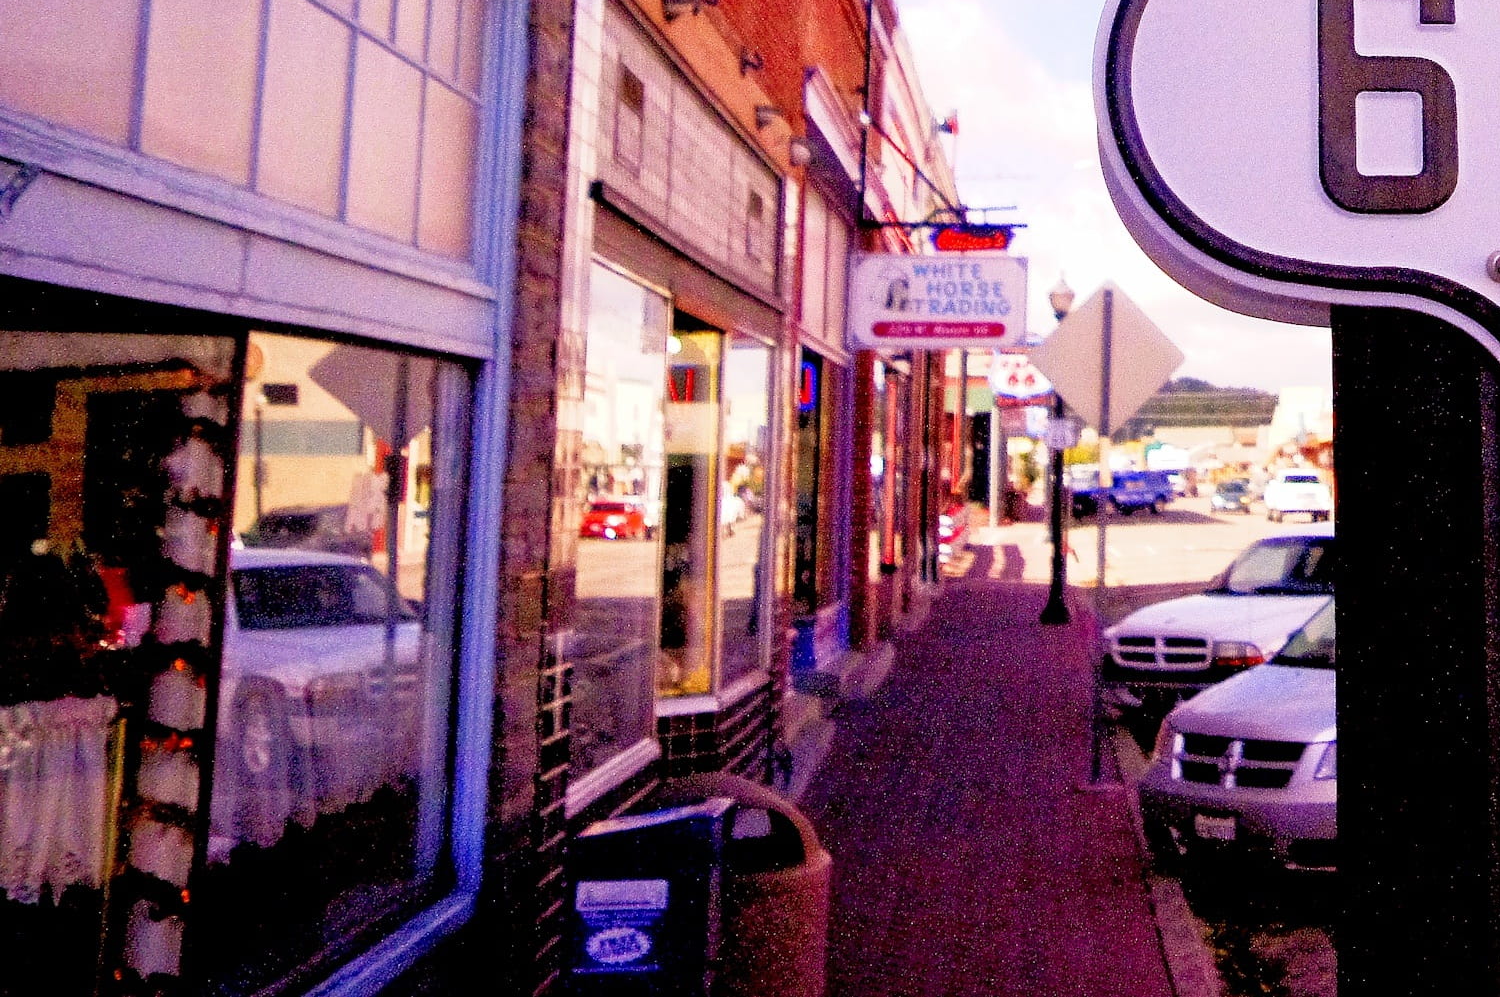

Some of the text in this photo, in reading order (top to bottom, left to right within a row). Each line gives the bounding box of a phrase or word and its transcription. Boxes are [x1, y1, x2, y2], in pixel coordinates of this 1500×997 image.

[913, 263, 981, 279] WHITE
[927, 280, 1004, 297] HORSE
[912, 298, 1012, 316] TRADING
